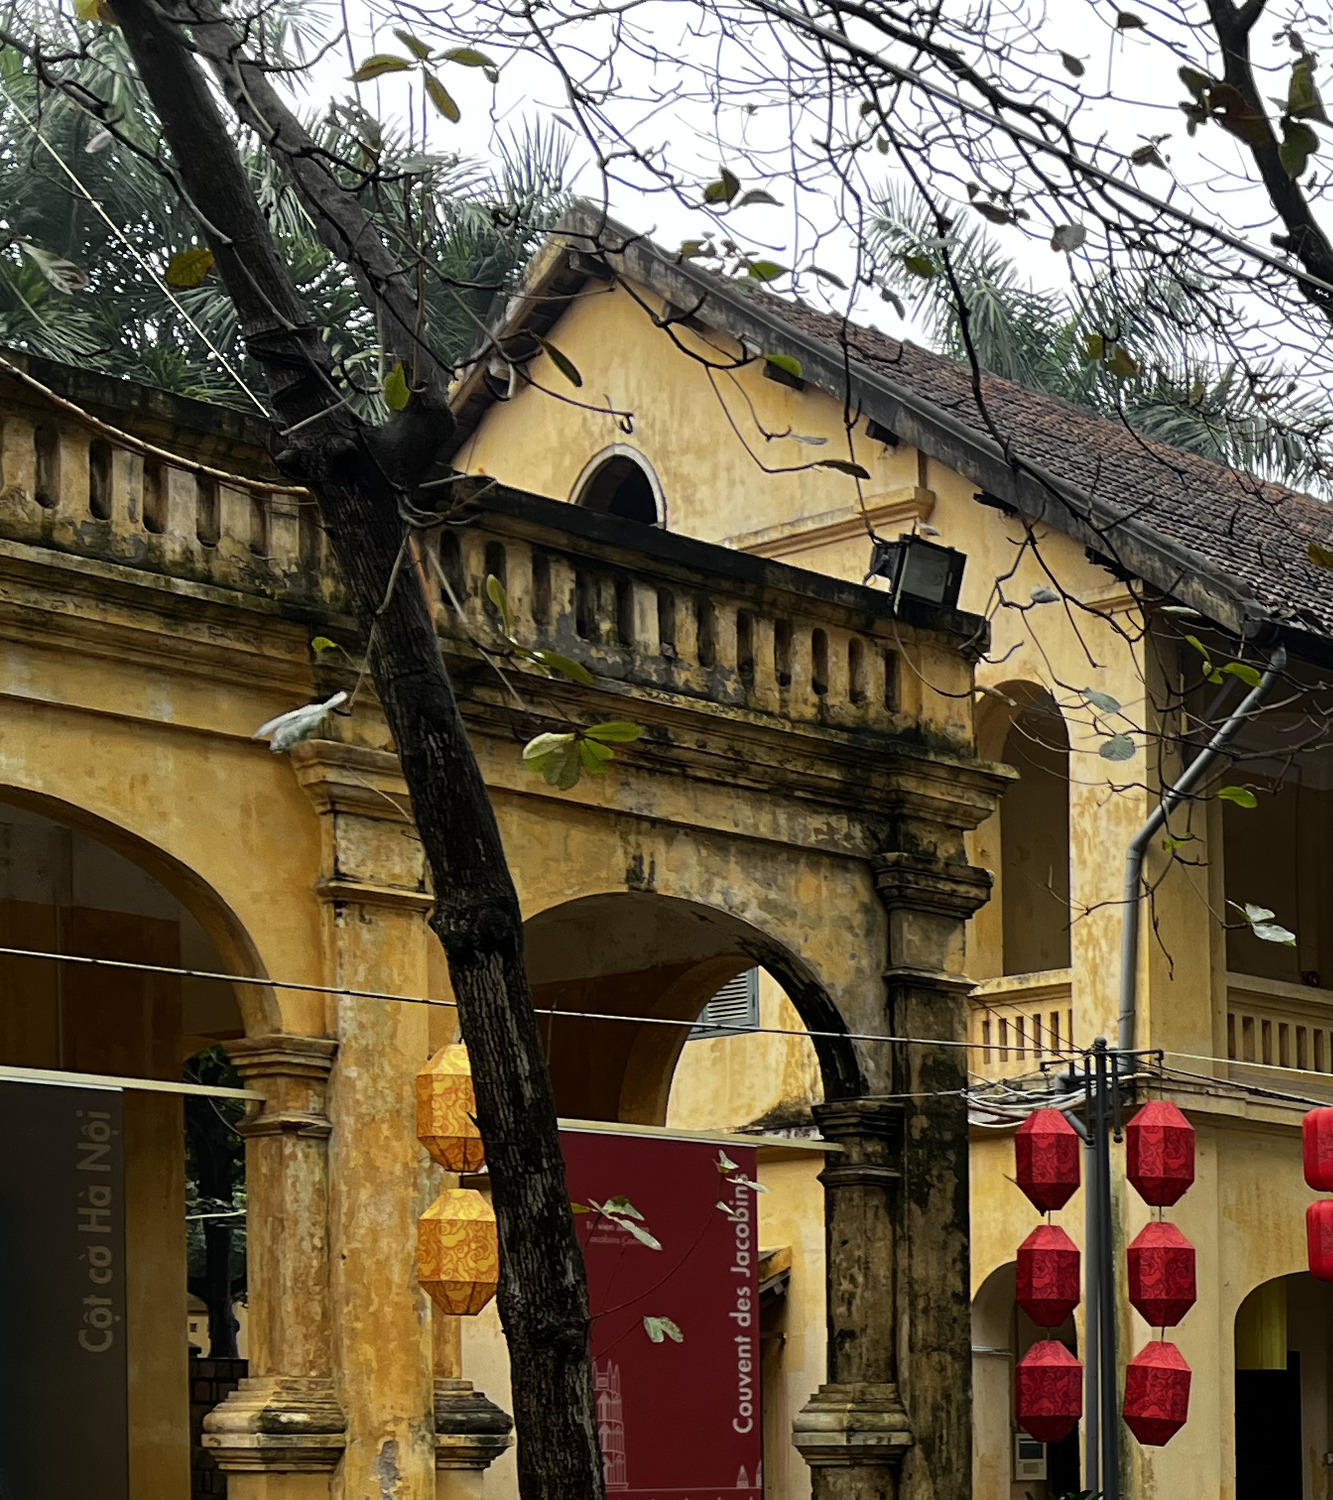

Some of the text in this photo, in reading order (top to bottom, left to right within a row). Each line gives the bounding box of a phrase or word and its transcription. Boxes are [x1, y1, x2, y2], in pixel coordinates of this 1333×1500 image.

[75, 1109, 121, 1353] Cột cờ Hà Nội
[727, 1173, 754, 1434] Couvent des Jacobins
